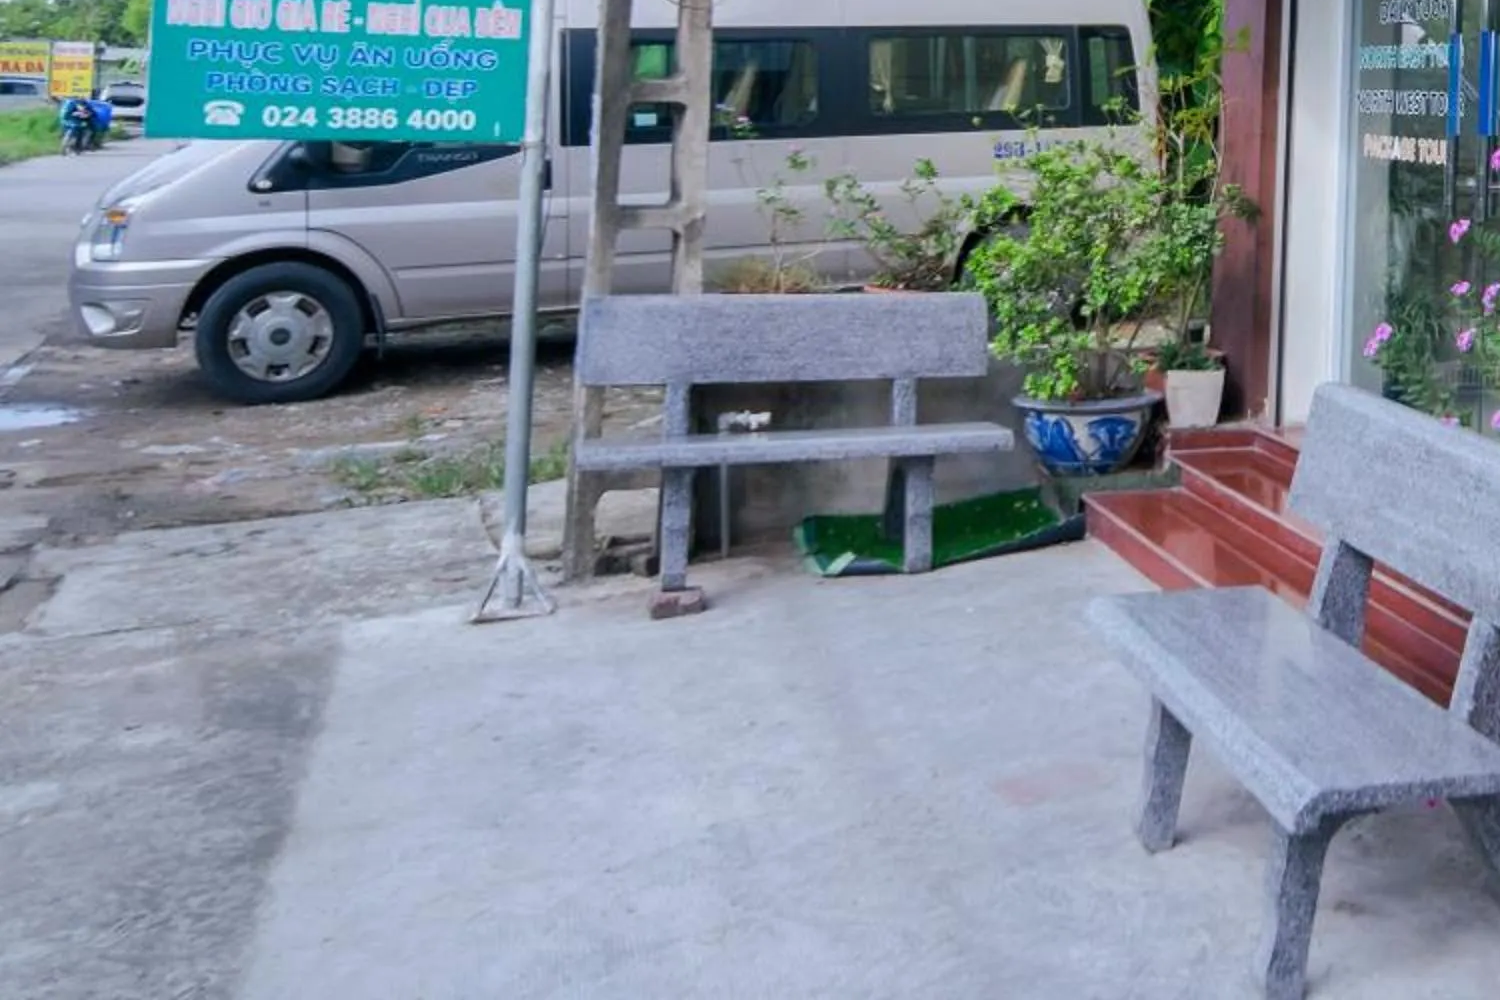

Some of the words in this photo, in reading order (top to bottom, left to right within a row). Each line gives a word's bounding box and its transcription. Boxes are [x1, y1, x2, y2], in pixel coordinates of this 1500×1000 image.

[187, 39, 283, 69] PHỤC
[292, 42, 339, 71] VỤ
[348, 42, 396, 67] ĂN
[404, 37, 497, 70] UỐNG
[206, 66, 312, 95] PHÒNG
[319, 75, 400, 101] SẠCH
[262, 104, 318, 128] 024
[326, 106, 399, 130] 3886
[406, 108, 477, 132] 4000
